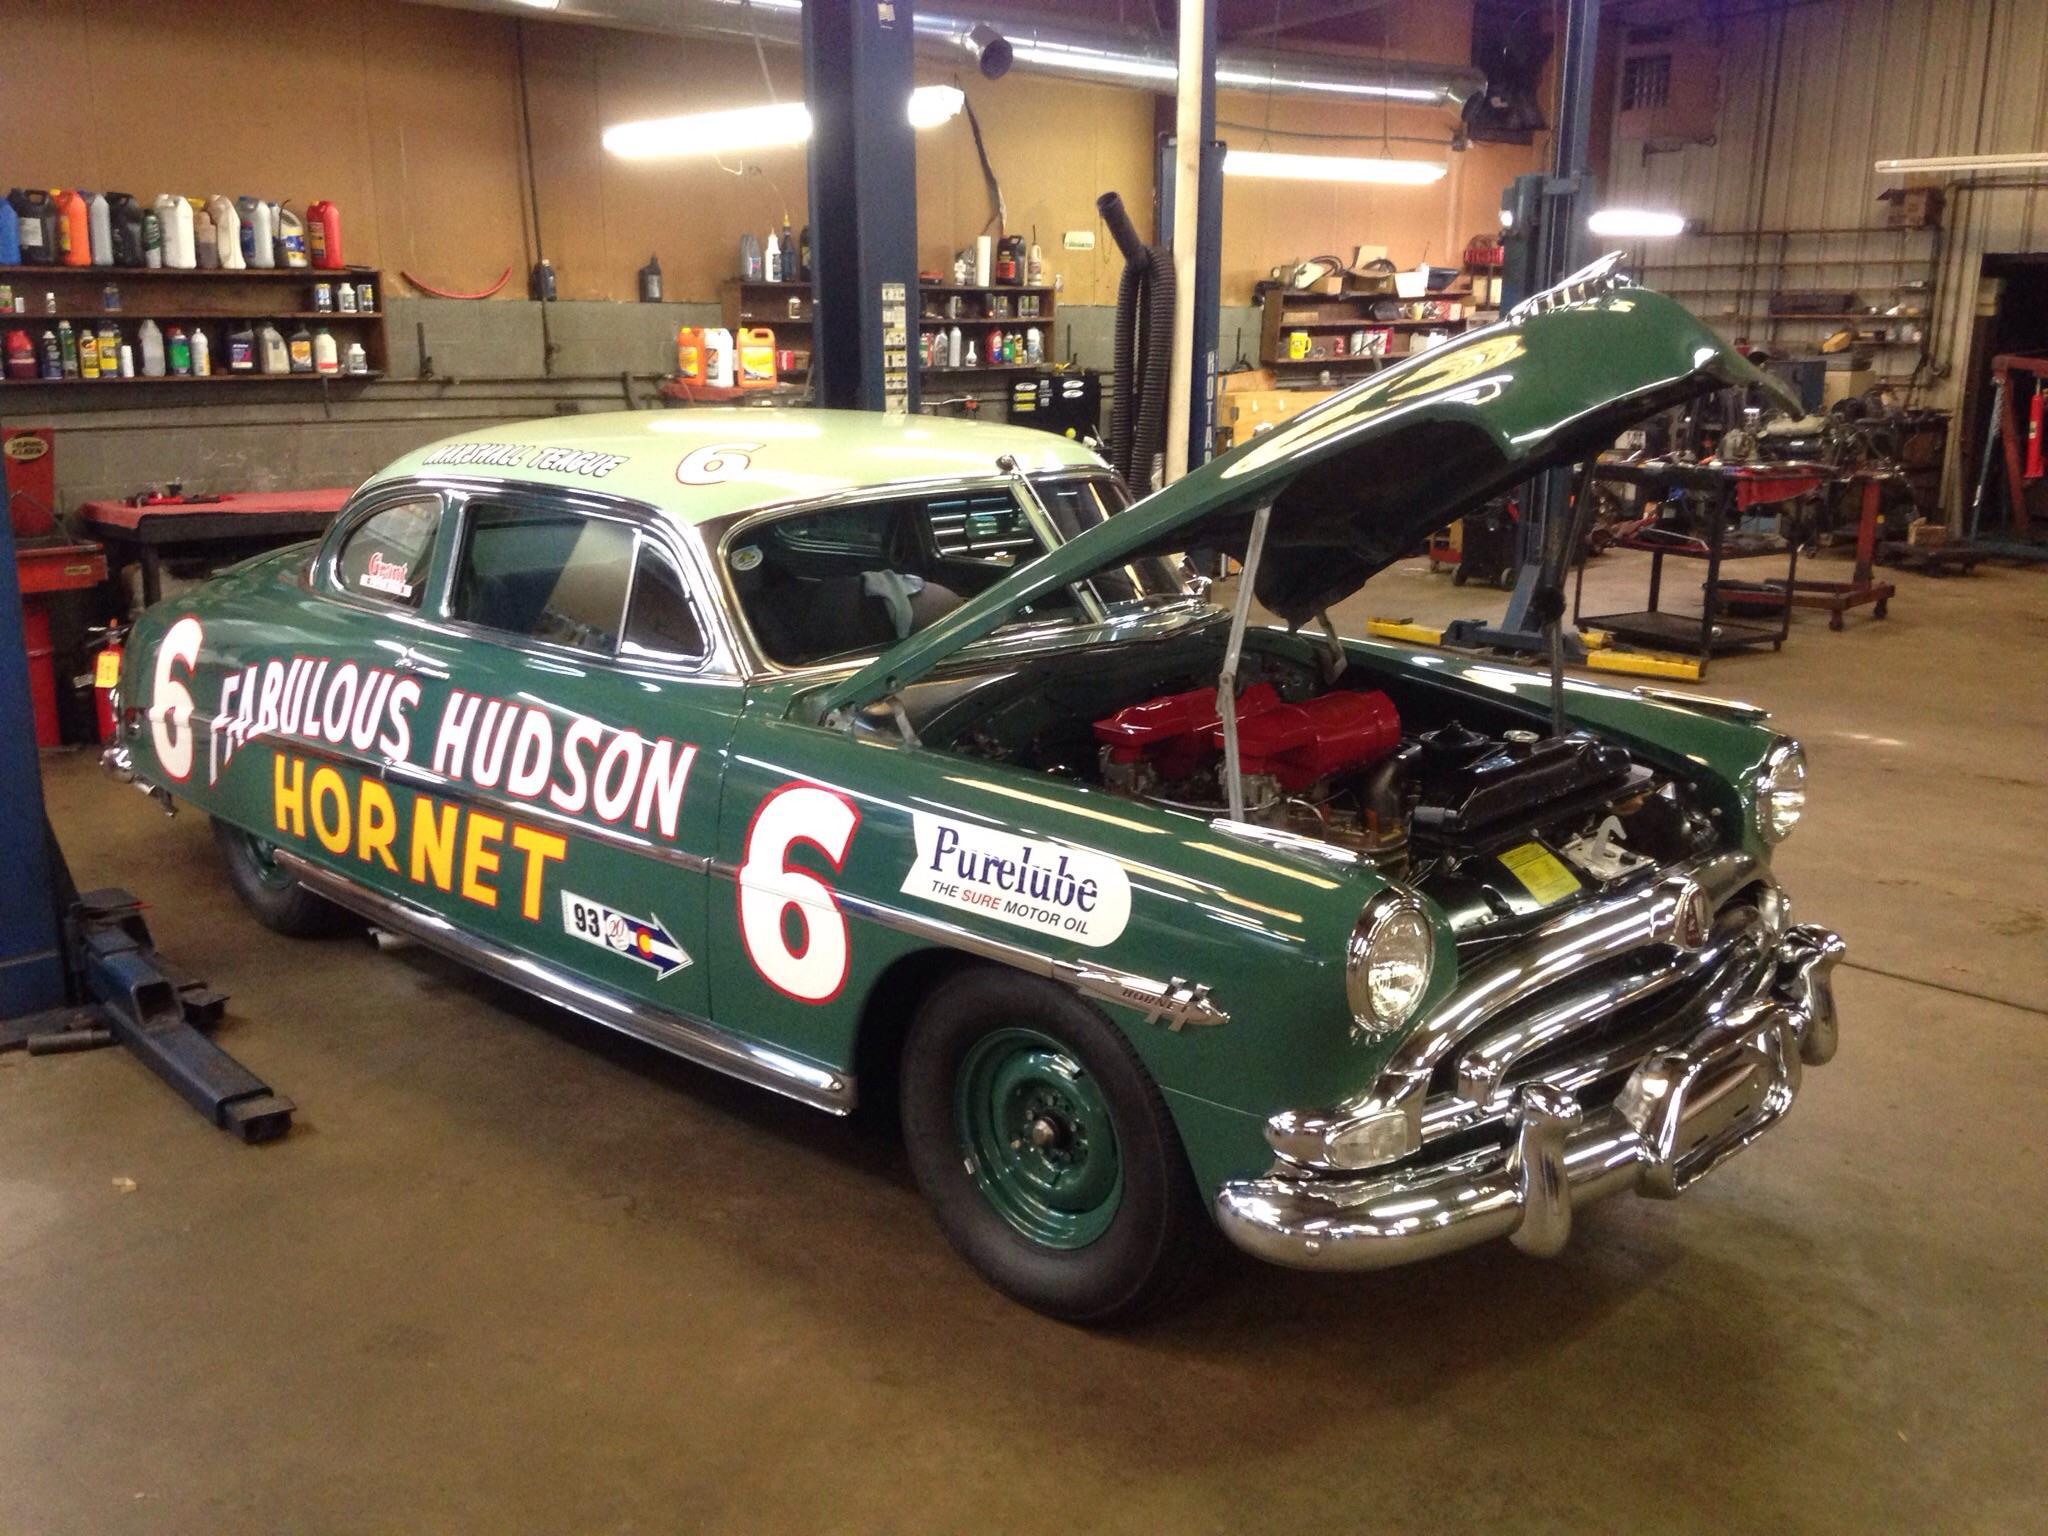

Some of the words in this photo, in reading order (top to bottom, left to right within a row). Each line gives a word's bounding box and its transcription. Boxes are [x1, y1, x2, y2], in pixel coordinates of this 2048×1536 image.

[422, 443, 535, 466] MARSHALL
[526, 446, 630, 478] TEAGUE
[675, 442, 768, 486] 6
[147, 614, 204, 783] 6
[208, 657, 420, 789] FABULOUS
[432, 689, 698, 841] HUDSON
[272, 752, 568, 925] HORNET
[930, 826, 1098, 912] Purelube
[574, 903, 600, 937] 93
[735, 779, 862, 1006] 6
[931, 880, 960, 898] THE
[961, 889, 1001, 910] SURE
[1003, 901, 1060, 927] MOTOR
[1064, 917, 1089, 935] OIL
